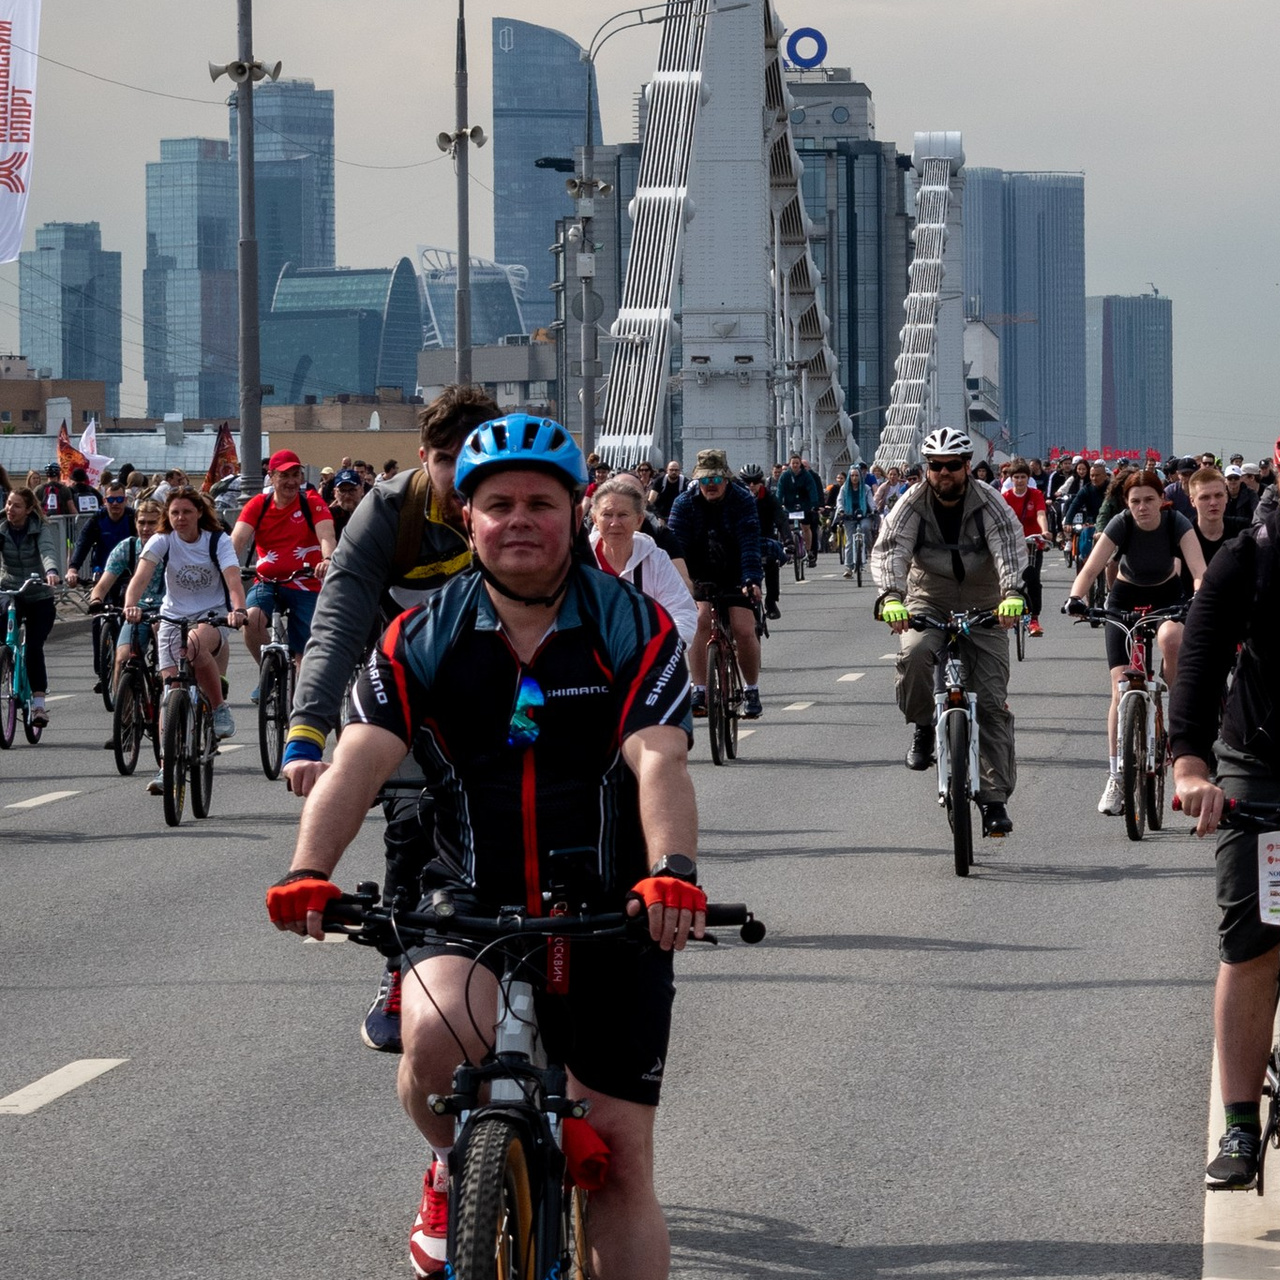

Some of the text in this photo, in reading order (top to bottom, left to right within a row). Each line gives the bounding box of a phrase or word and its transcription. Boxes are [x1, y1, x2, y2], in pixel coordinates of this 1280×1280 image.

[9, 85, 32, 143] СПОРТ
[1103, 446, 1141, 460] Банк
[553, 937, 564, 982] ОСКВИЧ
